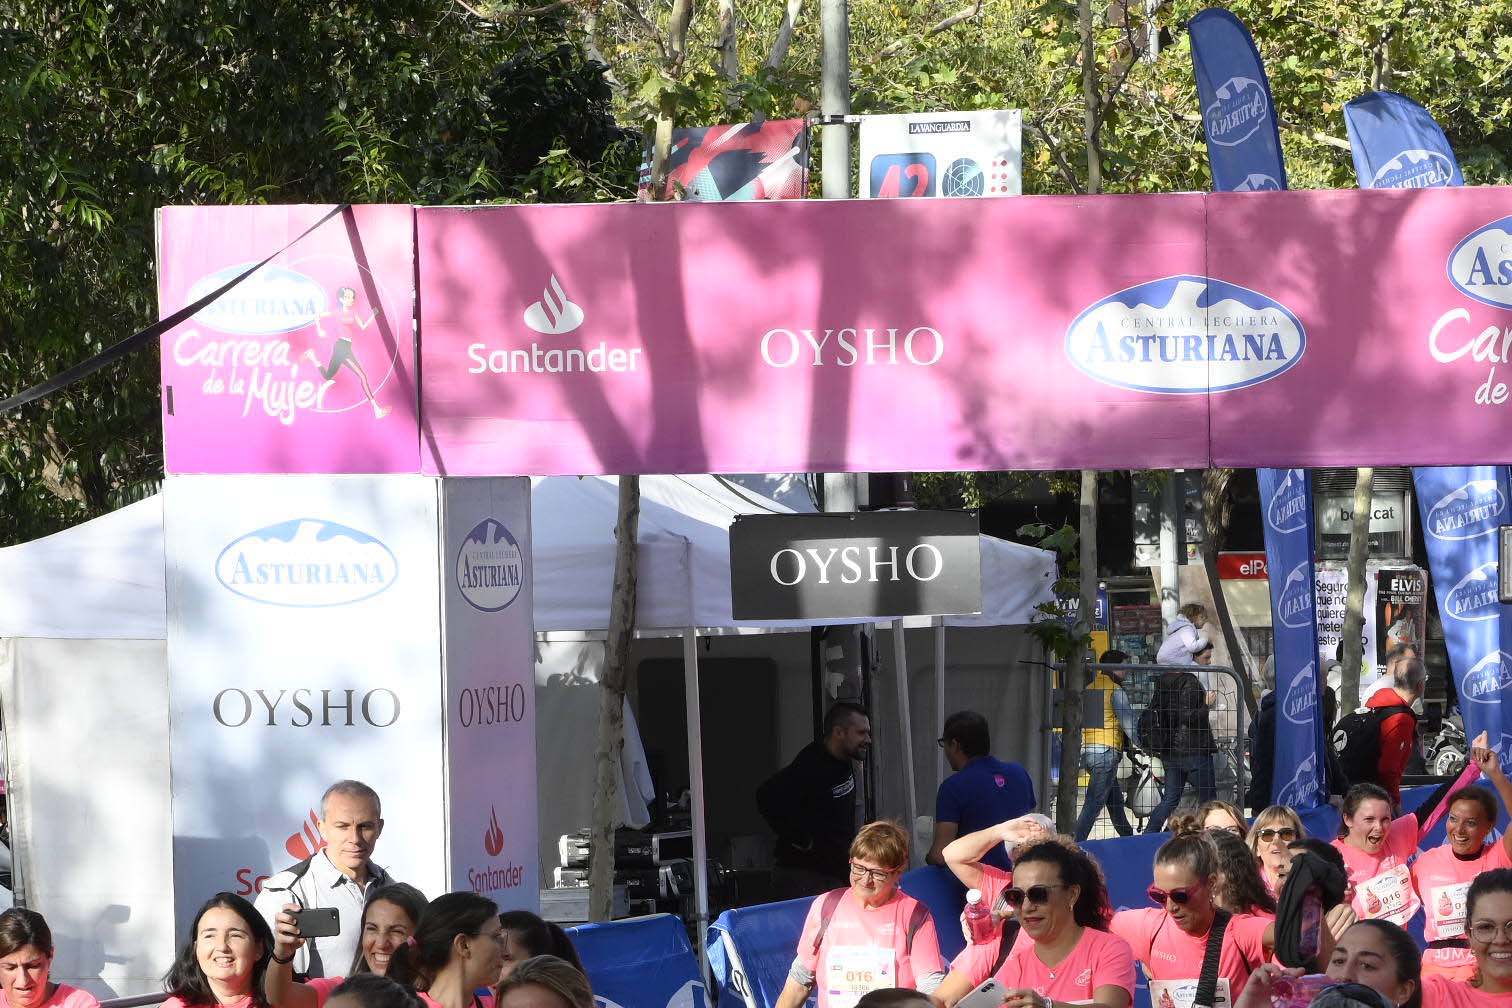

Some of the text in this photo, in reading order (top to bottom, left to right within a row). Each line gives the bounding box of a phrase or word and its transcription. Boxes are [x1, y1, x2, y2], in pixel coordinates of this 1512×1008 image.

[208, 298, 316, 315] STURIANA
[1202, 315, 1279, 327] LECHERA
[174, 330, 289, 367] Carrera
[468, 342, 642, 374] Santander
[760, 327, 944, 368] OYSHO
[1086, 321, 1287, 362] ASTURIANA
[243, 366, 336, 426] Mujer
[1474, 367, 1509, 405] de
[230, 551, 385, 585] ASTURIANA
[462, 555, 519, 588] ASTURIANA
[770, 544, 943, 586] OYSHO
[1391, 578, 1421, 591] ELVIS
[212, 688, 400, 728] OYSHO
[459, 684, 525, 728] OYSHO
[468, 862, 523, 895] Santander
[1383, 891, 1400, 904] 016
